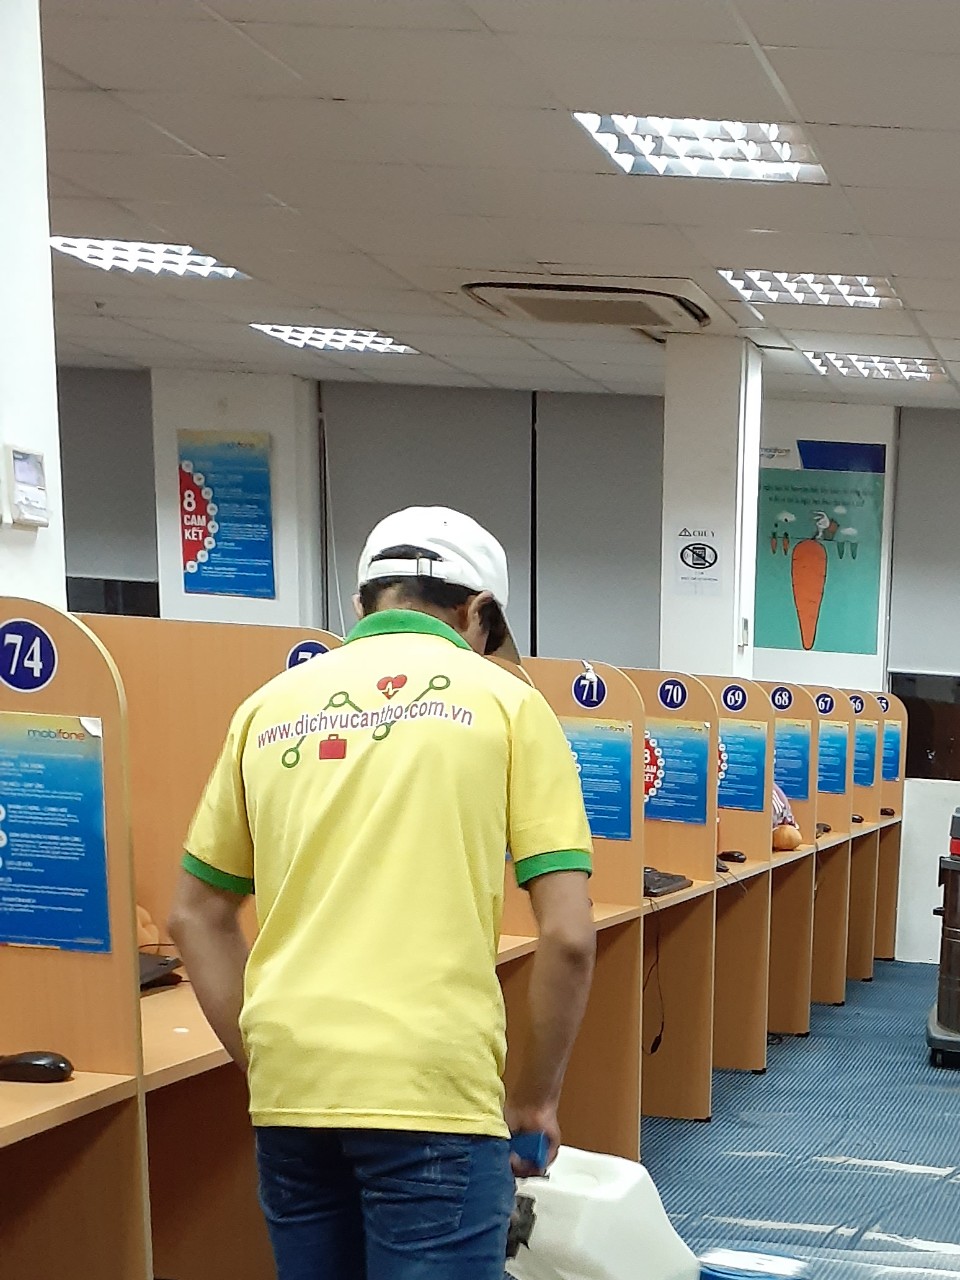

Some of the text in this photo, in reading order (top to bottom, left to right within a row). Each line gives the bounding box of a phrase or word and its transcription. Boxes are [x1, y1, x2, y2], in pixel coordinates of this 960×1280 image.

[183, 489, 196, 512] 8
[183, 514, 207, 526] CAM
[4, 633, 43, 678] 74
[579, 679, 599, 702] 71
[664, 684, 682, 704] 70
[726, 689, 743, 707] 69
[774, 691, 789, 706] 68
[818, 697, 832, 710] 67
[878, 699, 887, 711] 5
[257, 701, 473, 748] www.dichvucantho.com.vn
[27, 728, 85, 741] mobifone
[644, 765, 657, 773] AM
